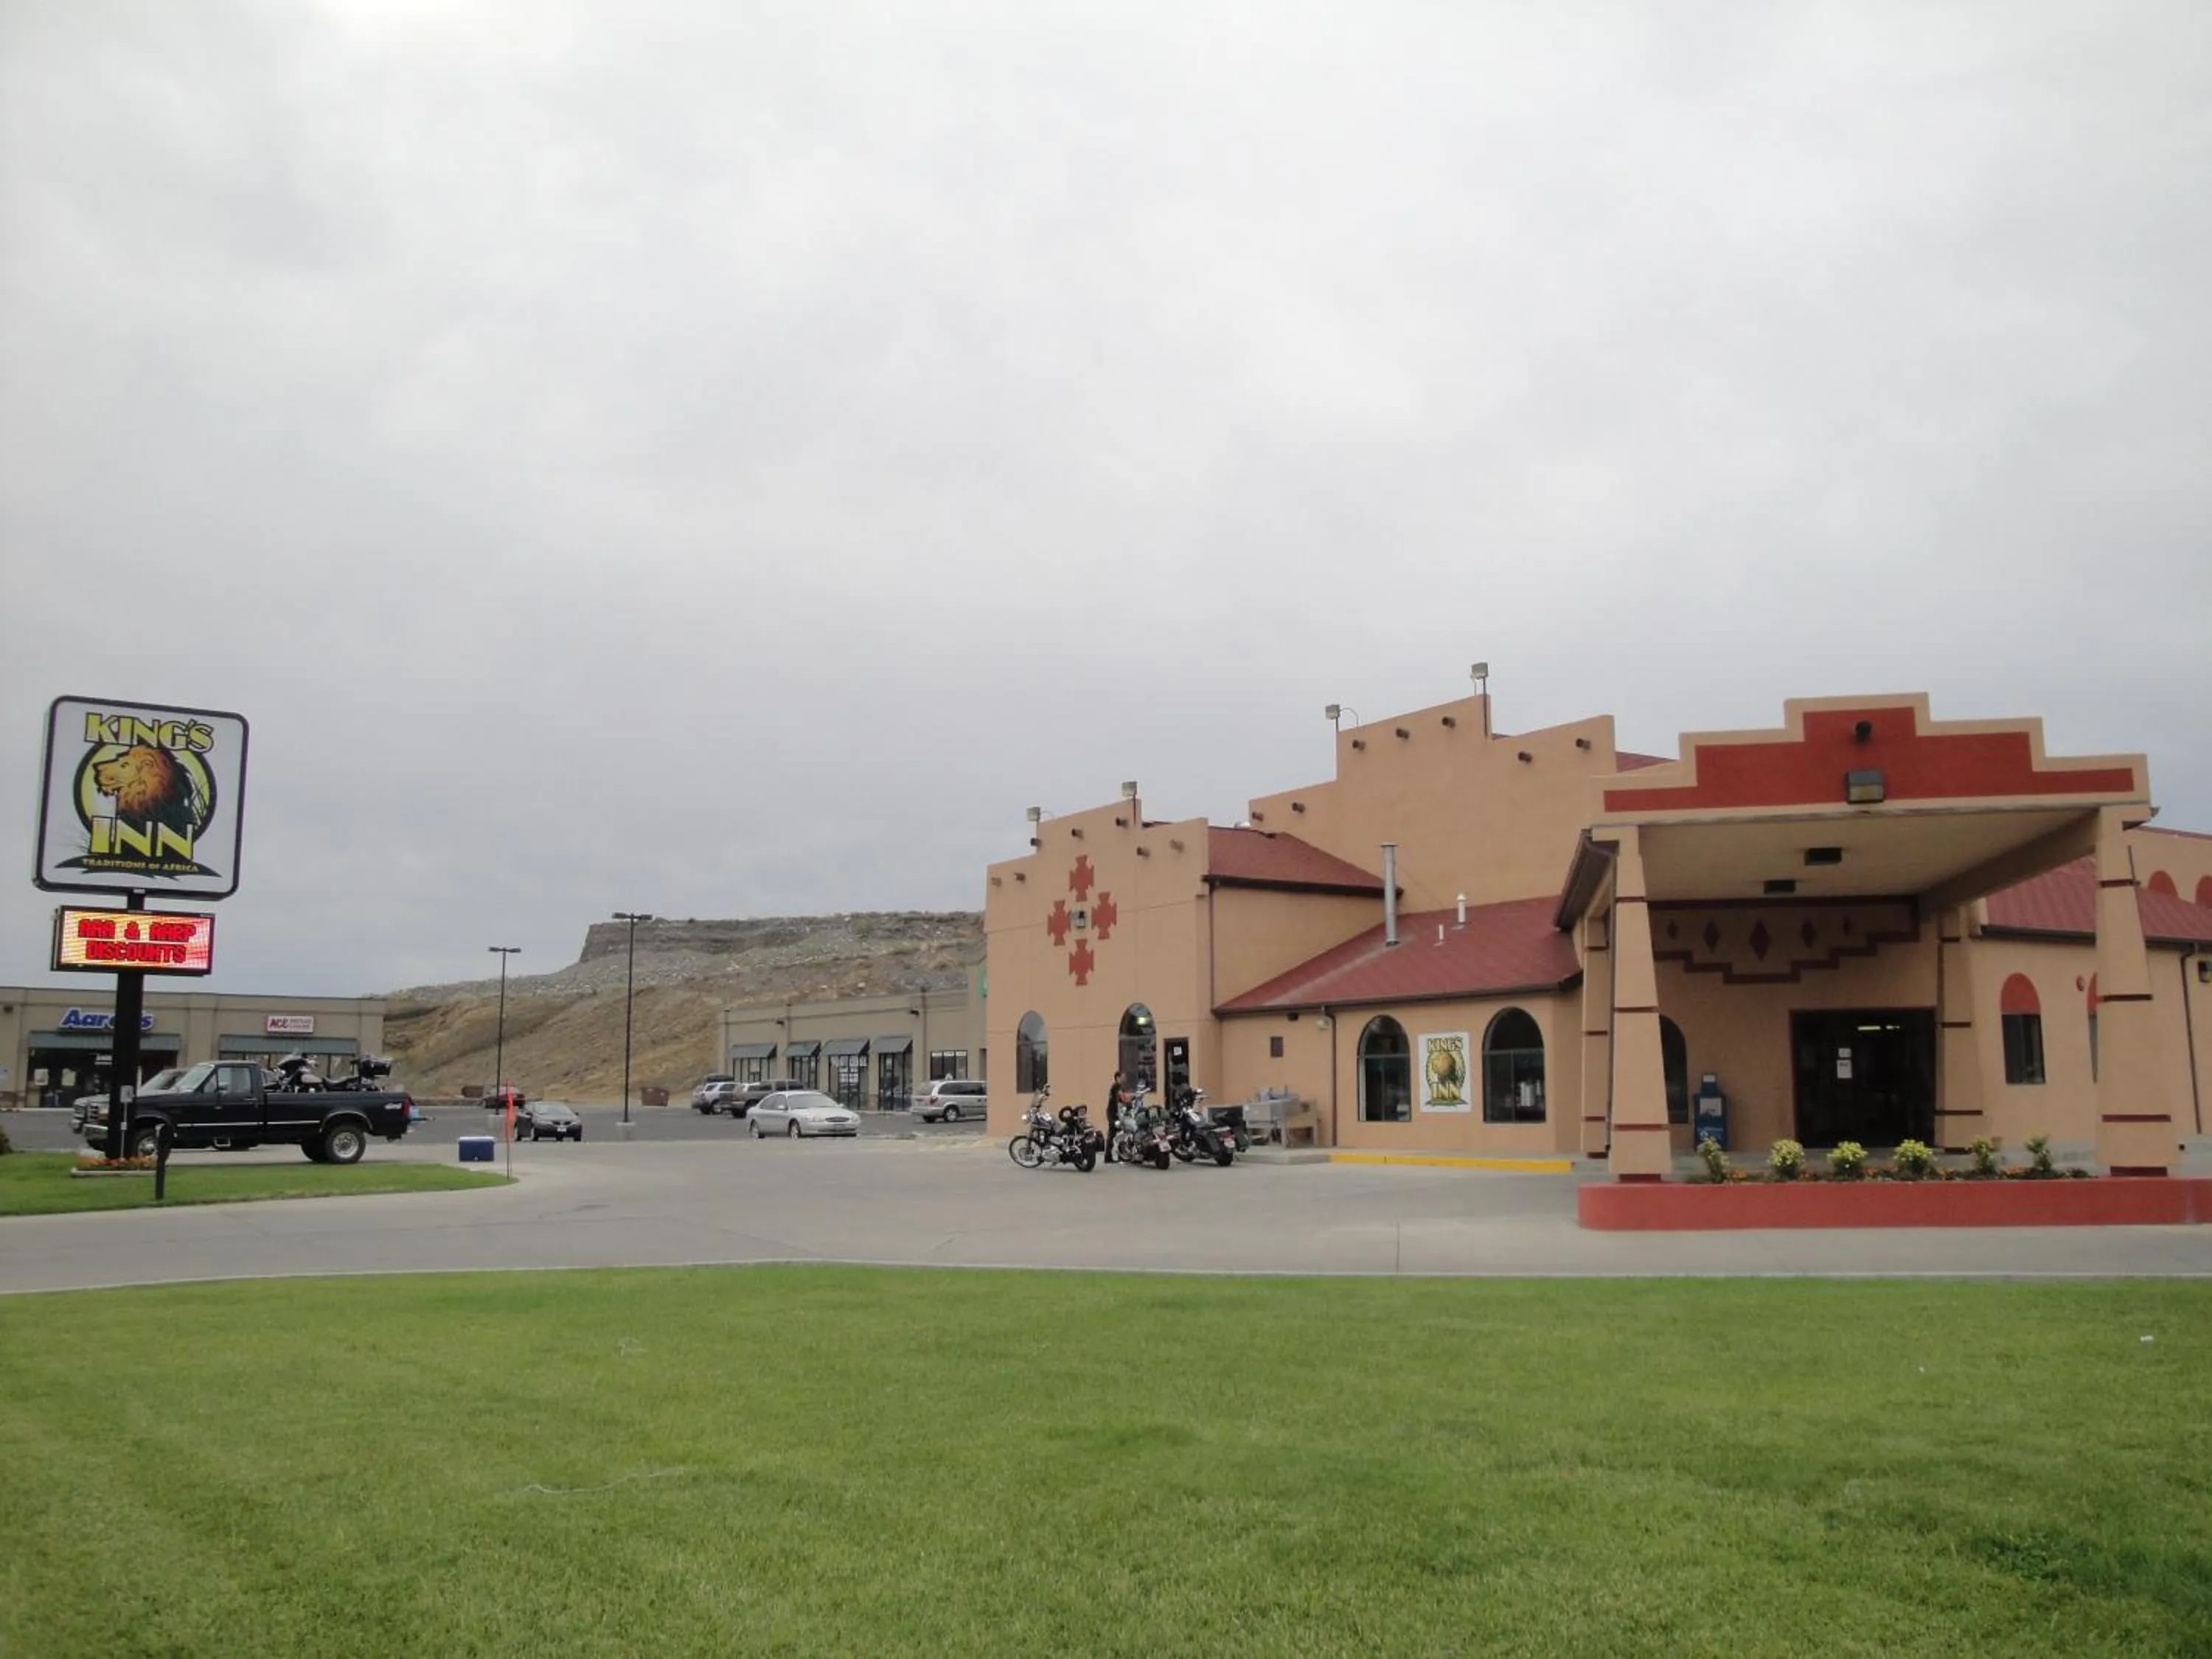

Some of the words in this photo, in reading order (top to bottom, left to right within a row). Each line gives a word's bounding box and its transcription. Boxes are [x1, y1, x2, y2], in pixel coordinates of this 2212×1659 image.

[84, 712, 214, 755] KING'S
[89, 815, 193, 860] INN
[82, 858, 146, 869] TRADITIONS
[86, 940, 187, 963] DISCOUNTS
[59, 1007, 154, 1030] Aars
[1431, 1082, 1460, 1100] INN
